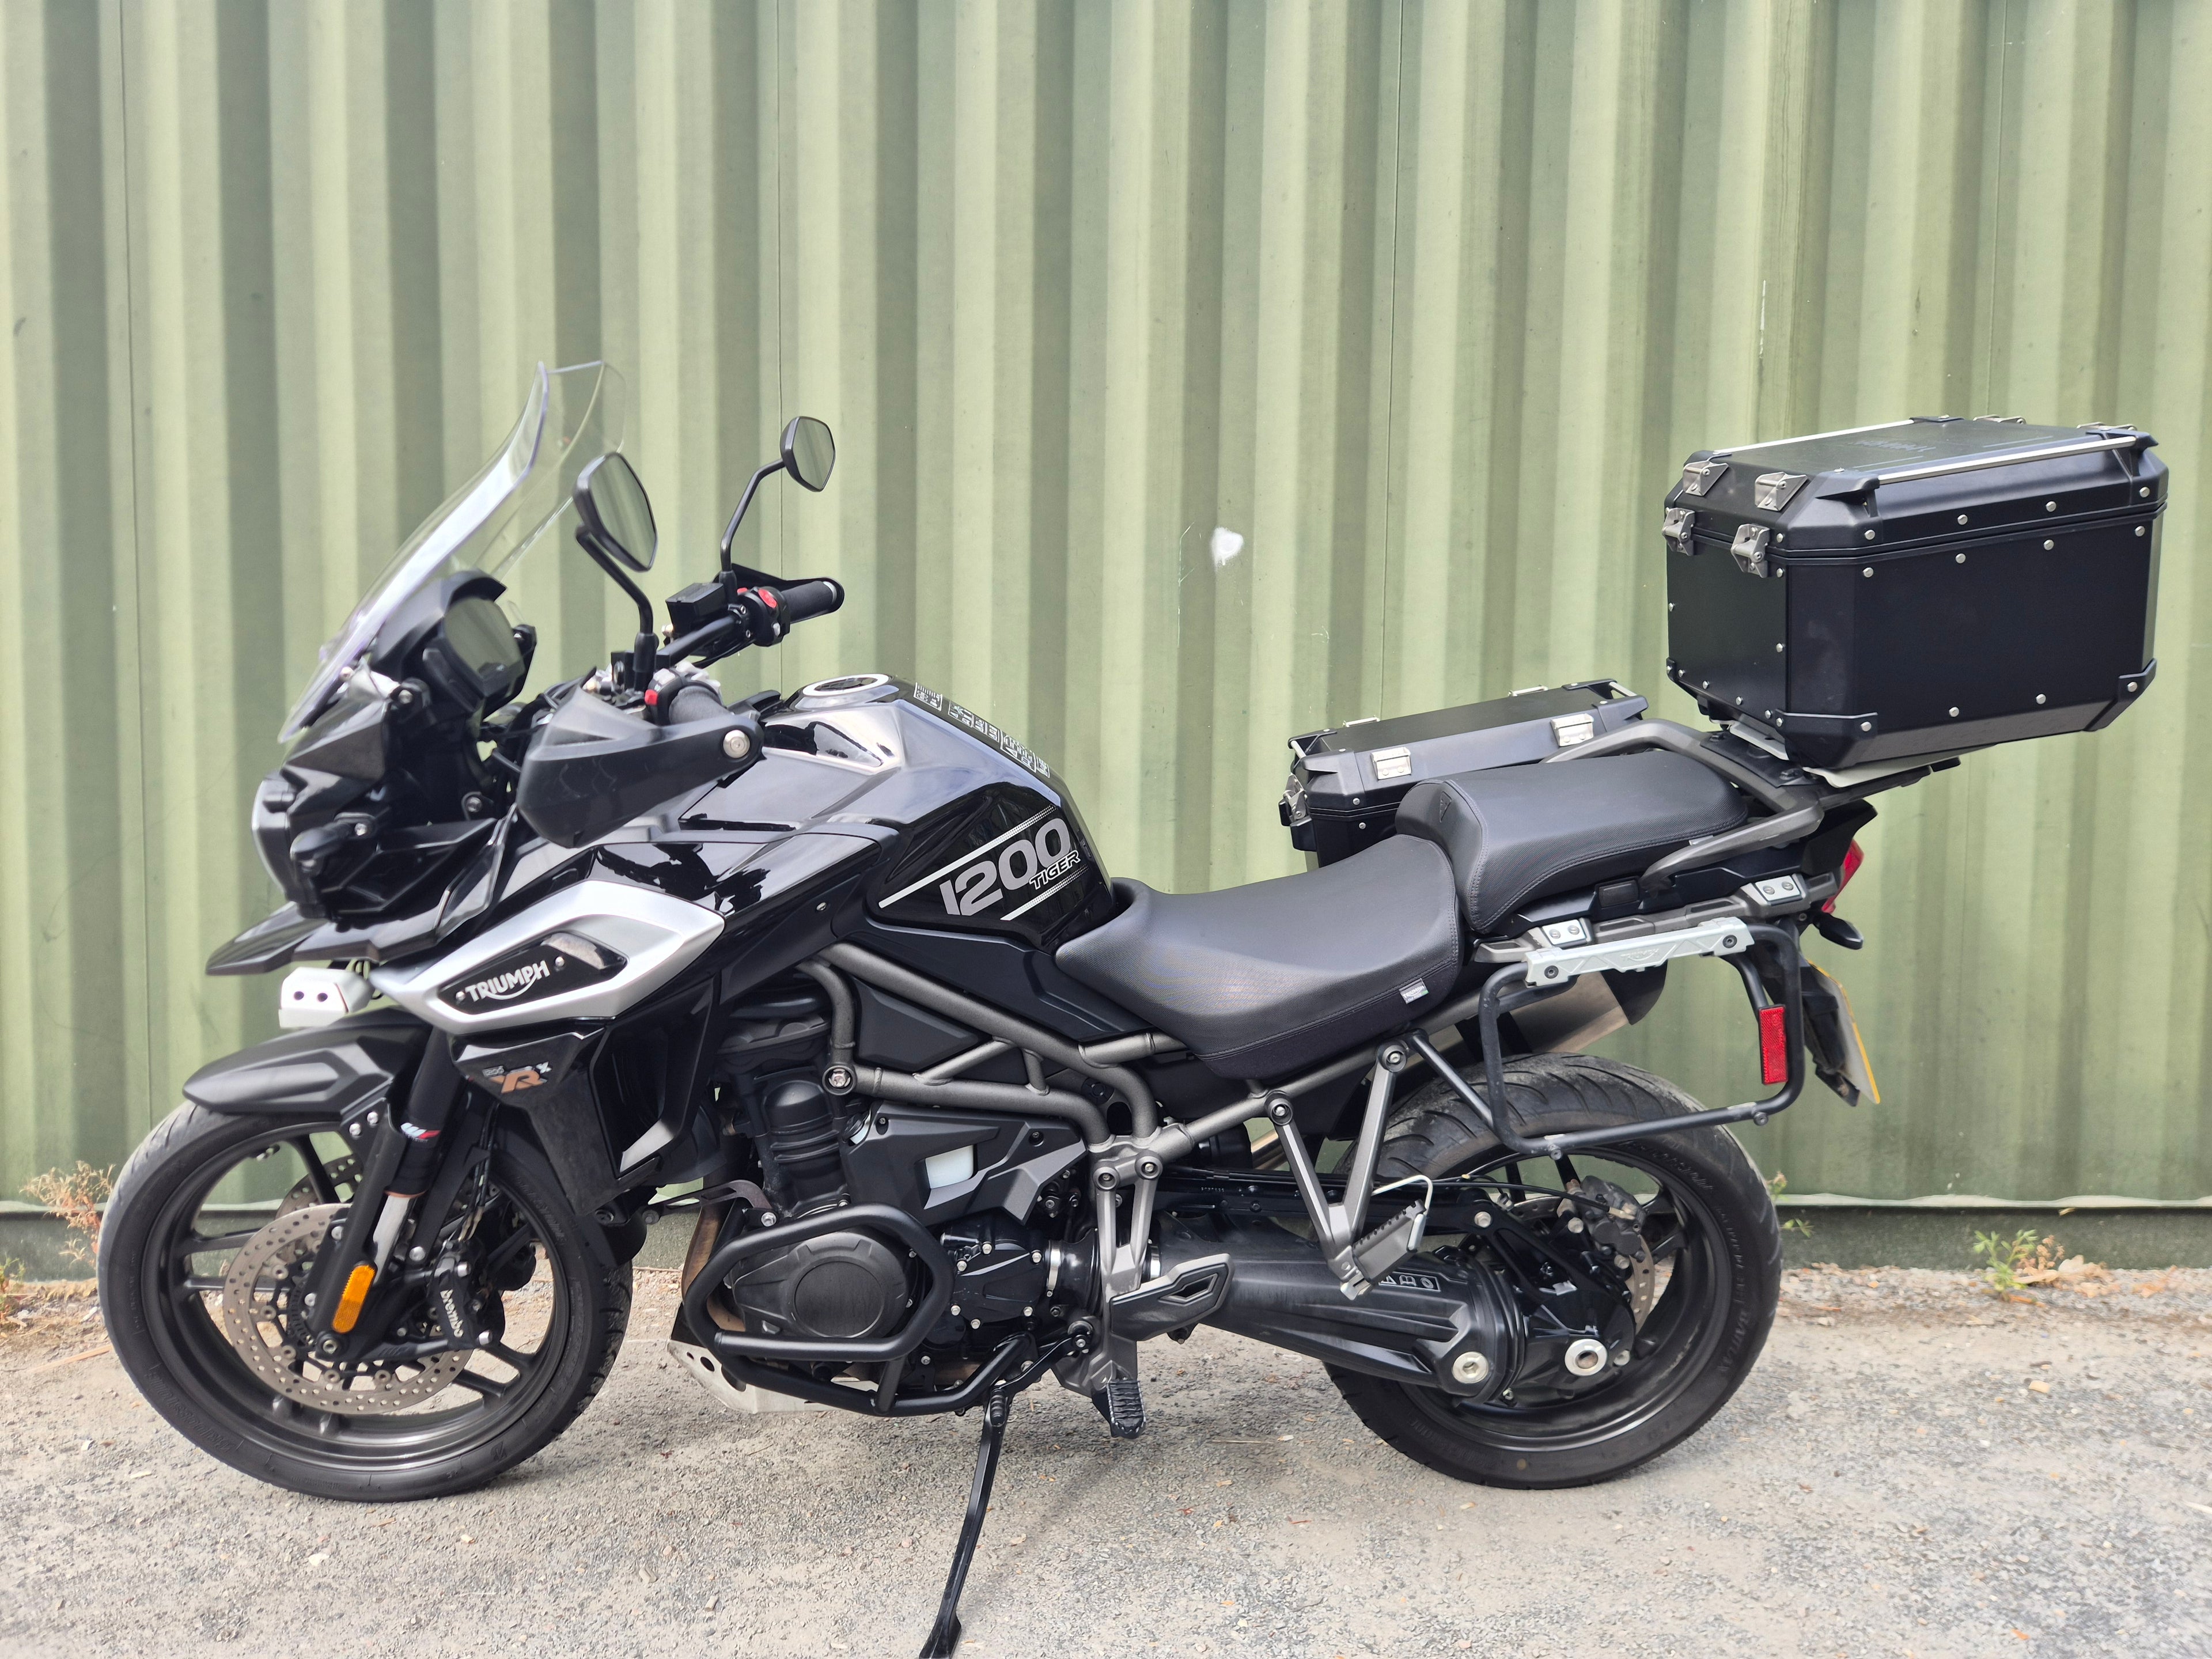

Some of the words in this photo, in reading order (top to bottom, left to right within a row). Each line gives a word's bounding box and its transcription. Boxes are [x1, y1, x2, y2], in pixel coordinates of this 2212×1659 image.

[940, 818, 1071, 916] 1200
[1029, 850, 1081, 890] TIGER
[465, 960, 551, 1002] TRIUMPH
[1403, 986, 1425, 998] TRIUMPH
[440, 1289, 464, 1338] brembo
